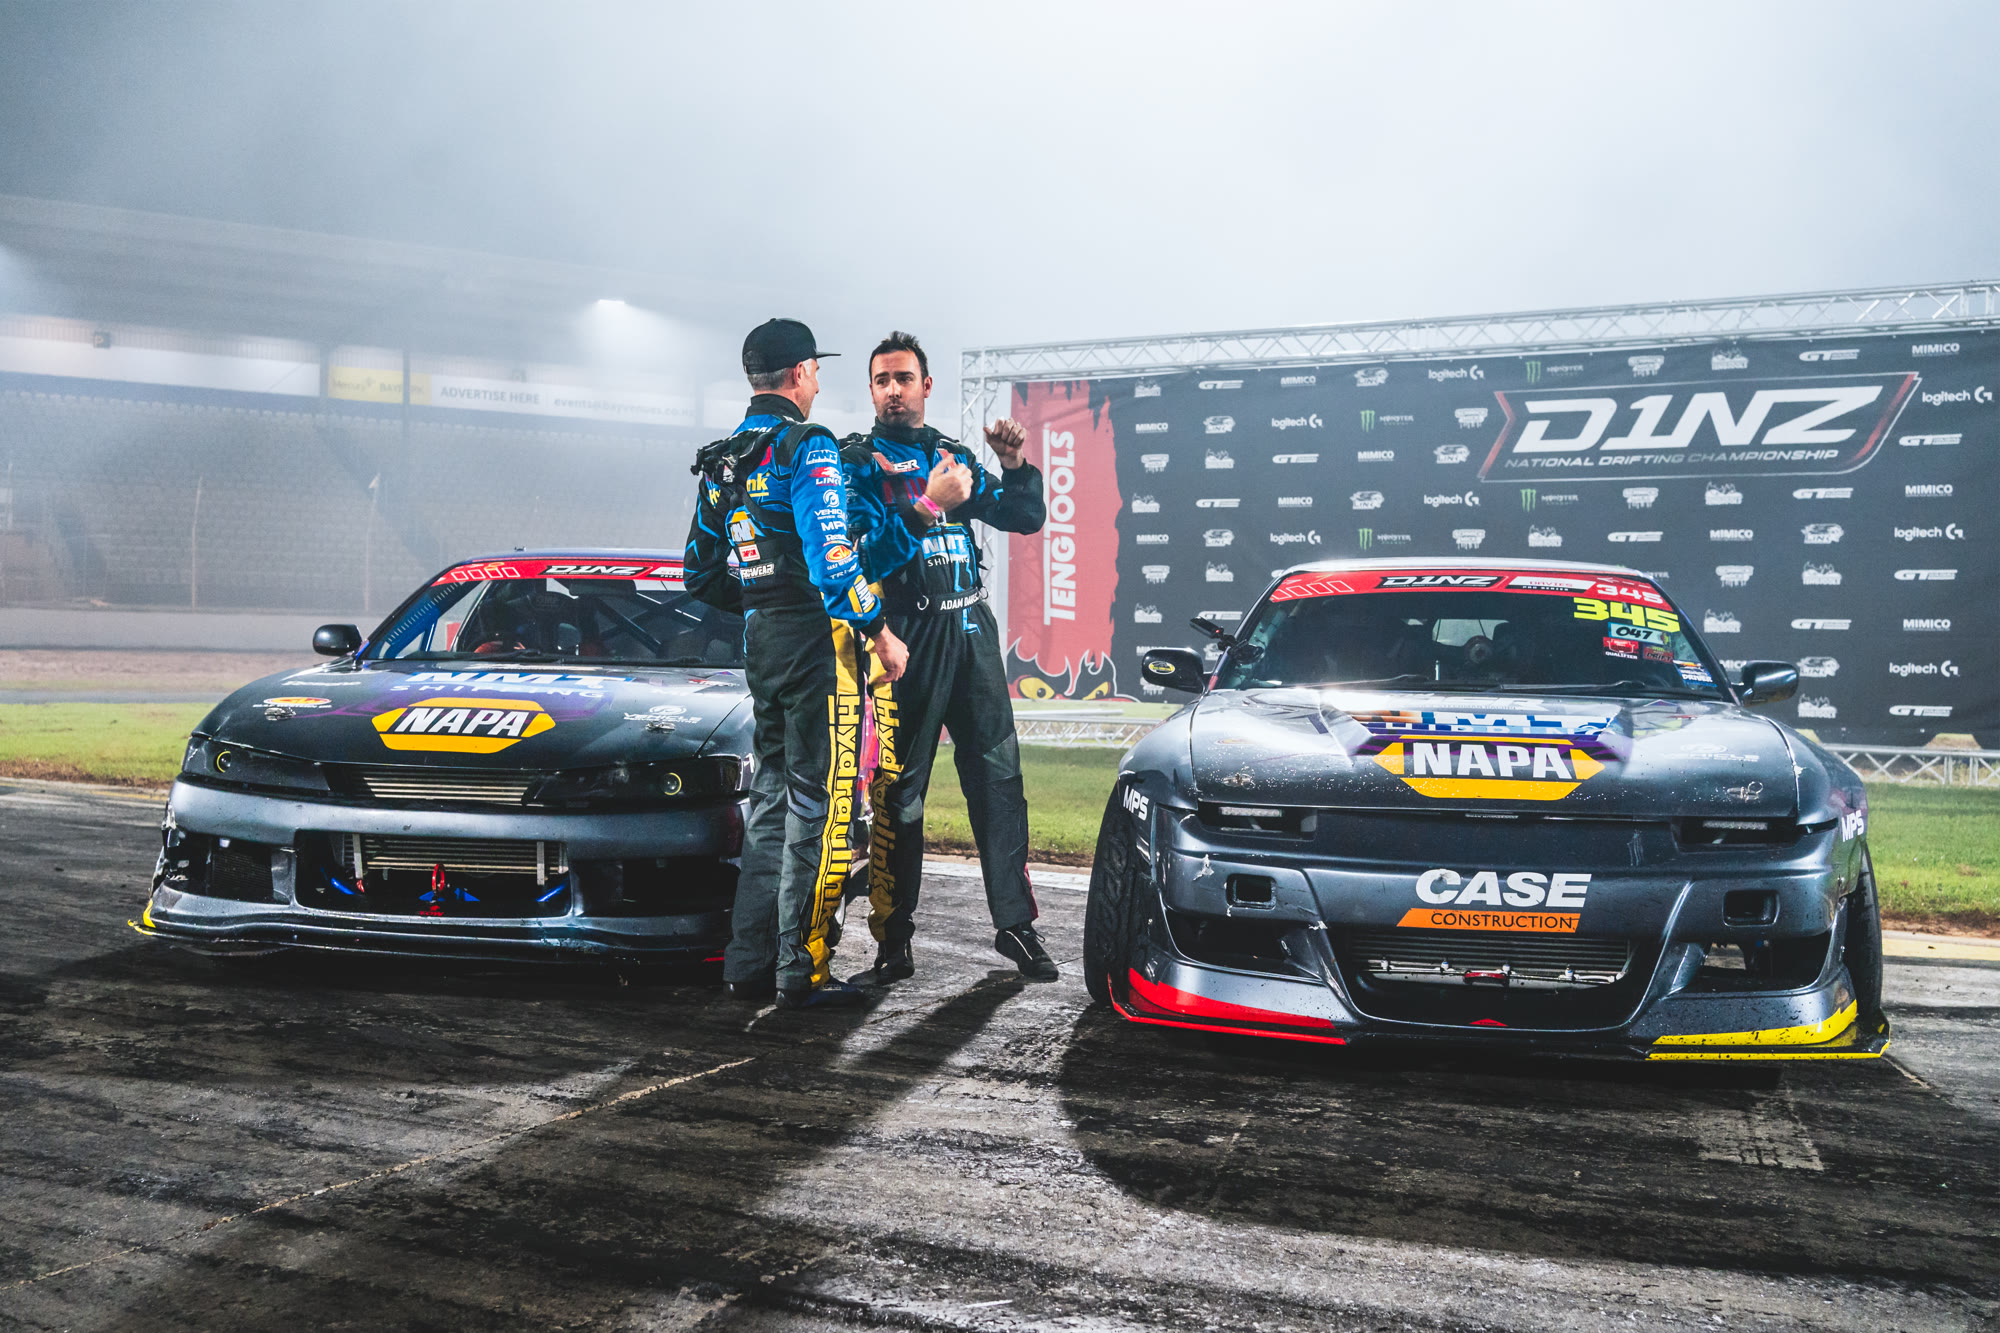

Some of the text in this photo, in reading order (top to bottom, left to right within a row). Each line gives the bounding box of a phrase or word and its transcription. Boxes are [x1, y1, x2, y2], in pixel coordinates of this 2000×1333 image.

[1911, 343, 1960, 354] MIMICO
[1280, 375, 1317, 386] MIMICO
[1428, 368, 1467, 382] logitech
[441, 386, 541, 405] ADVERTISE HERE
[1922, 390, 1971, 406] logitech
[1271, 417, 1307, 431] logitech
[1512, 385, 1883, 453] D1NZ
[1135, 422, 1168, 431] MIMICO
[1357, 450, 1395, 461] MIMICO
[1504, 449, 1839, 469] NATIONAL DRIFTING CHAMPIONSHIP
[1905, 484, 1953, 495] MIMICO
[1277, 496, 1313, 506] MIMICO
[1423, 493, 1462, 507] logitech
[1136, 534, 1169, 544] MIMICO
[1270, 532, 1306, 546] logitech
[1709, 529, 1754, 539] MIMICO
[1894, 527, 1942, 542] logitech
[546, 565, 643, 575] D1NZ
[1383, 576, 1498, 586] D1NZ
[1596, 584, 1664, 604] 345
[940, 598, 963, 610] ADAM
[1574, 597, 1680, 632] 345
[1902, 619, 1951, 629] MIMICO
[1616, 626, 1654, 640] 047
[1605, 651, 1638, 660] QUALIFIER
[1889, 663, 1937, 677] logitech
[394, 708, 529, 737] NAPA
[1412, 742, 1572, 779] NAPA
[1123, 785, 1149, 821] MPS
[820, 694, 860, 927] Hydraulink
[1841, 810, 1864, 842] MPS
[1415, 868, 1592, 908] CASE
[1431, 912, 1573, 930] CONSTRUCTION
